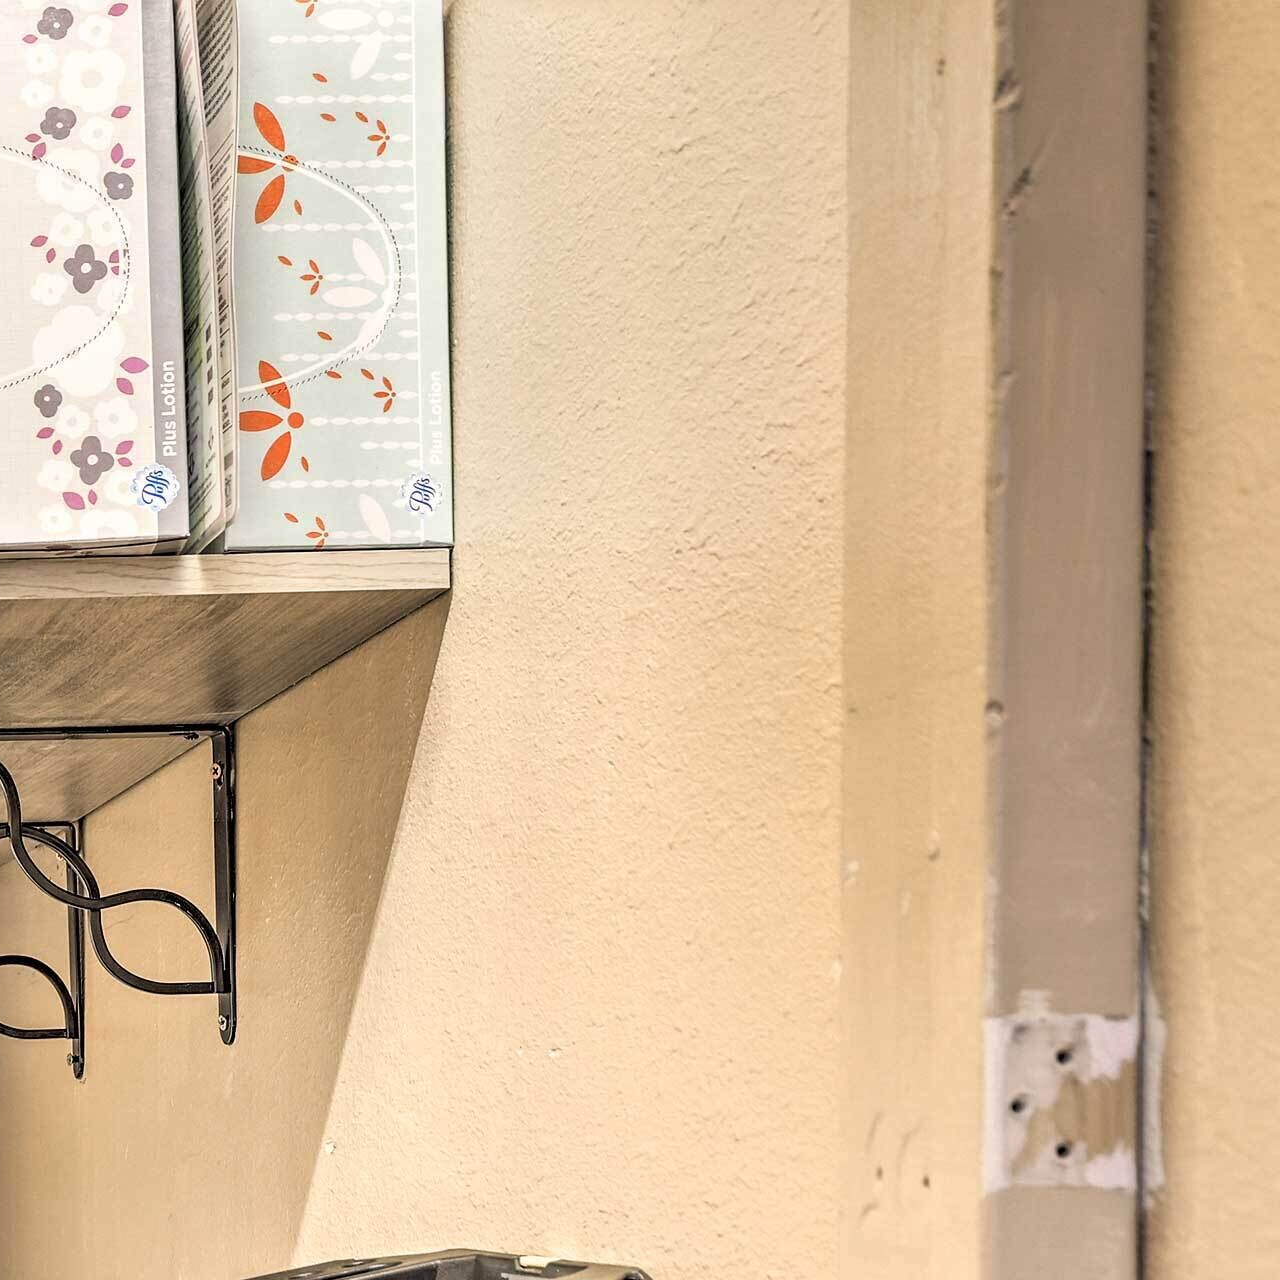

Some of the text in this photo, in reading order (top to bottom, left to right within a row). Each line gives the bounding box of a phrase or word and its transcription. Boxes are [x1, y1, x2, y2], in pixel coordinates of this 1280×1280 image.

[161, 360, 177, 457] Plus Lotion
[429, 371, 443, 426] Lotion
[142, 469, 170, 505] Puffs
[409, 477, 437, 512] Puffs
